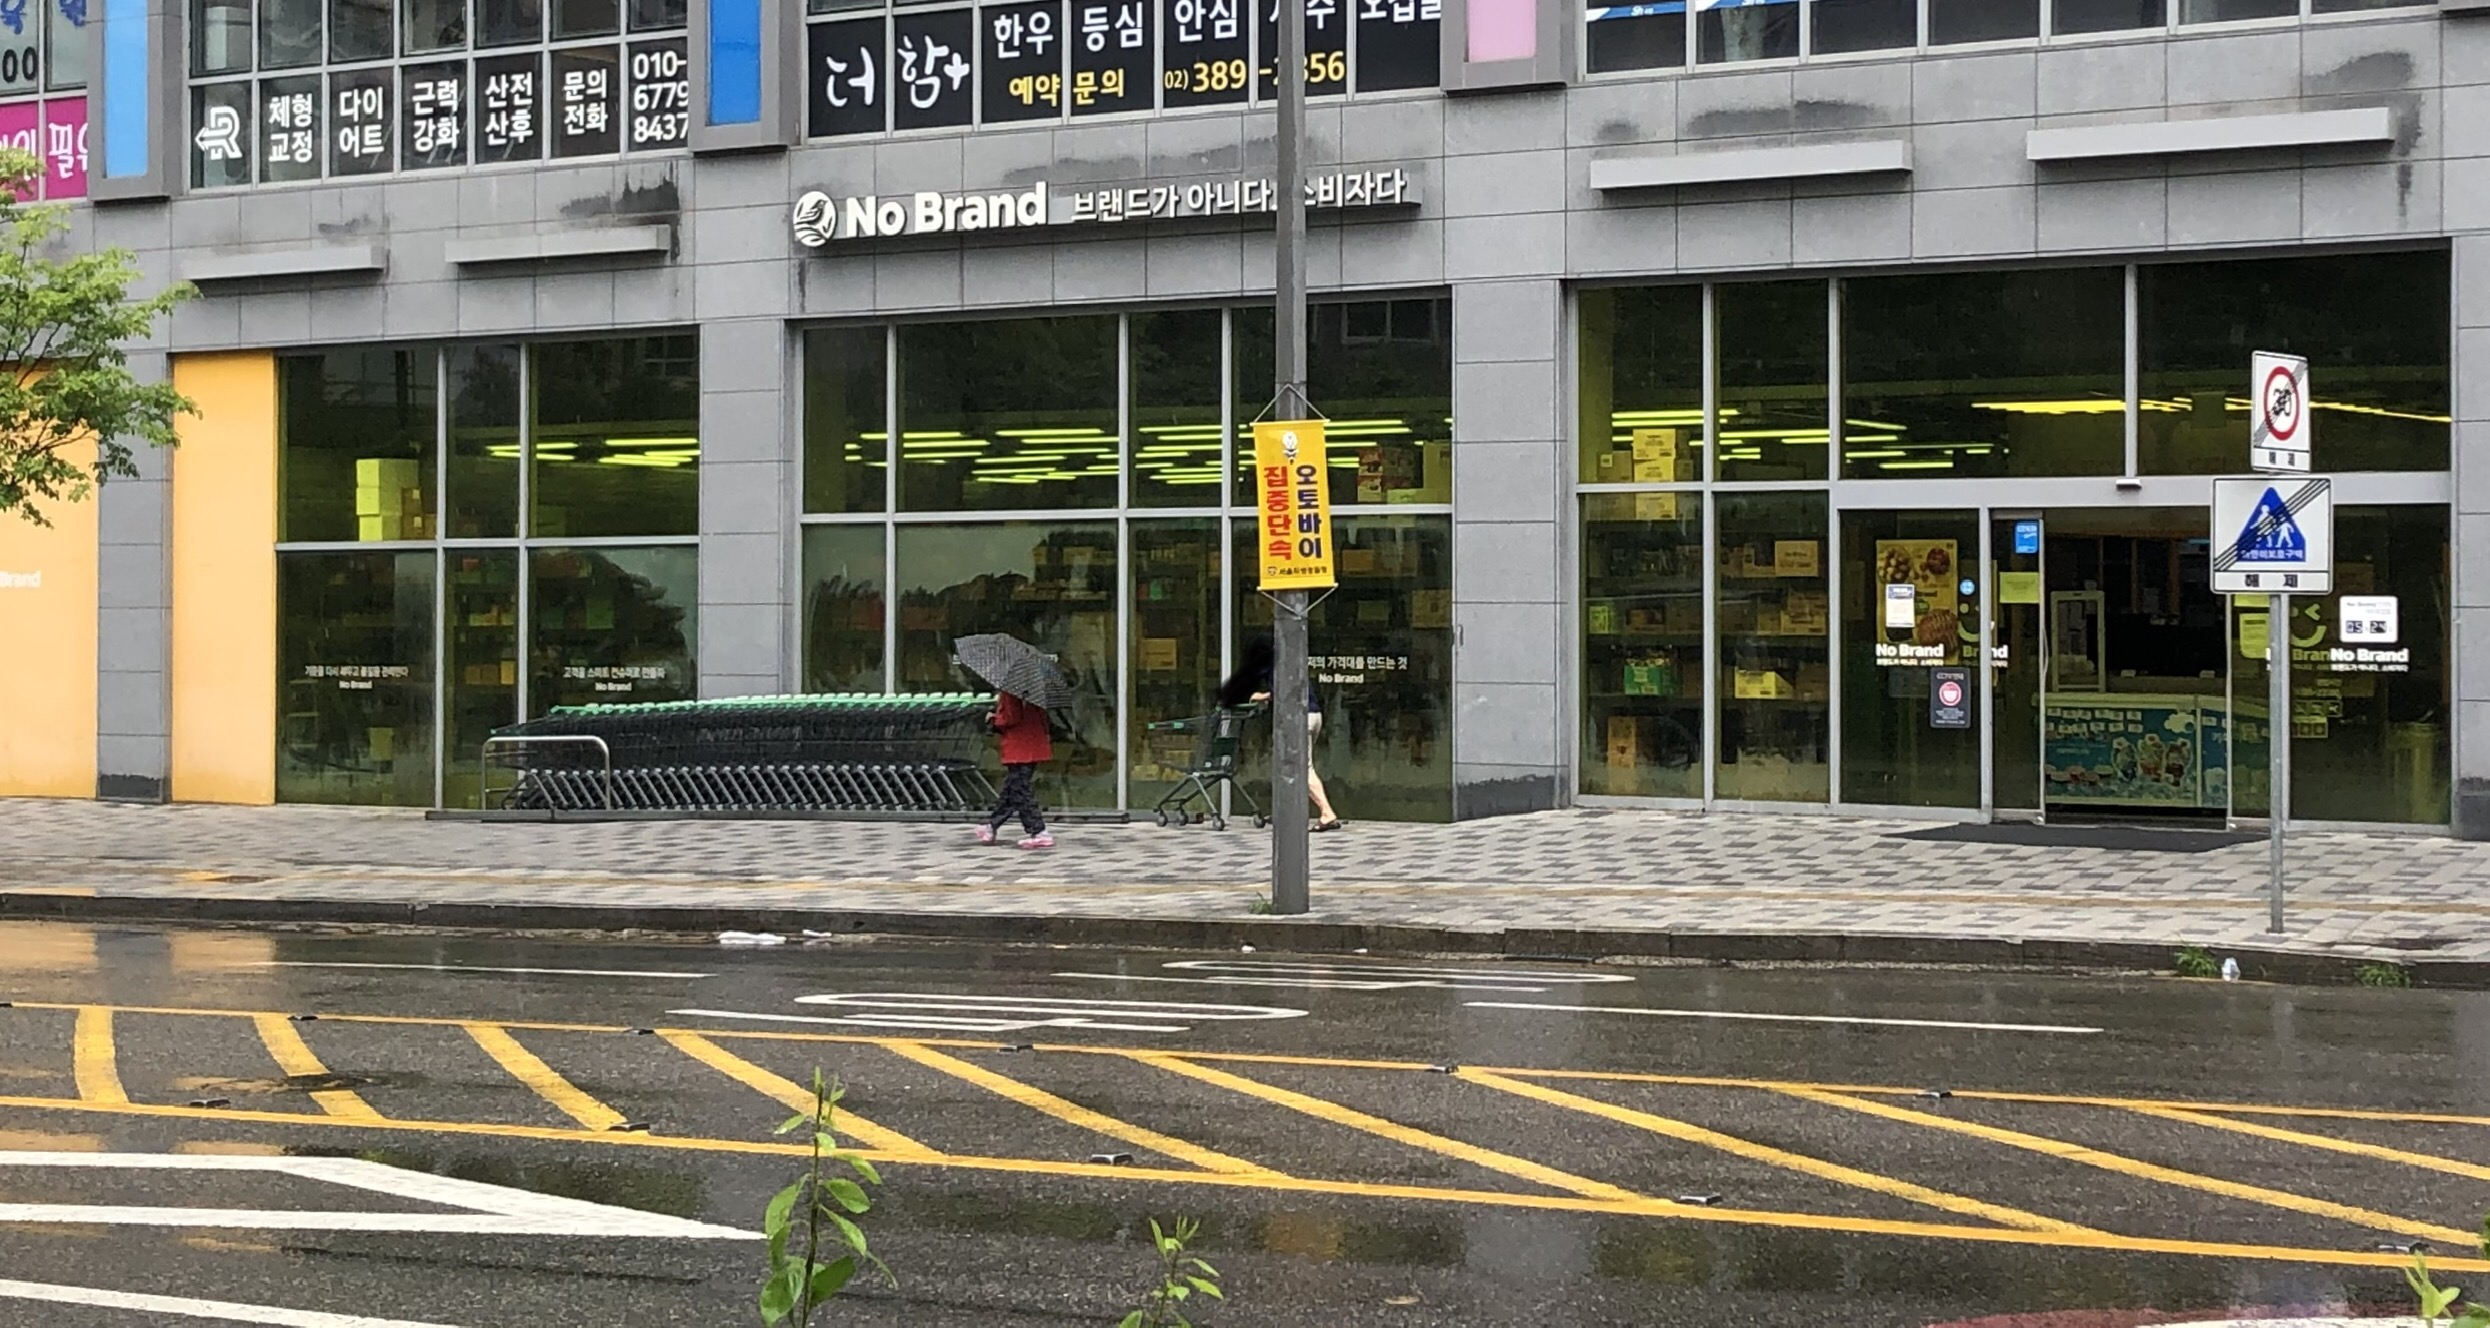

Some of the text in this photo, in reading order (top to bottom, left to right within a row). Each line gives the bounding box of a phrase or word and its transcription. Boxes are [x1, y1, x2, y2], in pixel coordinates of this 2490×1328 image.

[994, 11, 1053, 58] 한우
[1082, 3, 1143, 51] 등심
[1174, 0, 1237, 42] 안심
[633, 51, 687, 80] 010-
[412, 79, 458, 115] 근력
[485, 72, 533, 108] 산전
[563, 68, 607, 101] 문의
[633, 82, 689, 111] 6779
[1009, 73, 1060, 107] 예약
[1073, 68, 1125, 105] 문의
[268, 92, 313, 128] 체형
[339, 87, 383, 121] 다이
[564, 101, 608, 135] 전화
[339, 124, 384, 158] 어트
[413, 116, 460, 152] 강화
[485, 109, 534, 146] 산후
[633, 113, 689, 143] 8437
[268, 129, 313, 163] 교정
[846, 181, 1047, 238] No Brand
[1071, 184, 1179, 222] 브랜드가
[1264, 466, 1292, 560] 집중단속
[1296, 465, 1322, 558] 오토바이
[1367, 656, 1396, 670] 만드는
[1398, 656, 1408, 670] 것
[1876, 643, 1944, 657] No Brand
[2331, 647, 2409, 662] No Brand
[339, 681, 372, 689] No Brand
[595, 682, 632, 692] No Brand
[1319, 673, 1364, 684] No Brand
